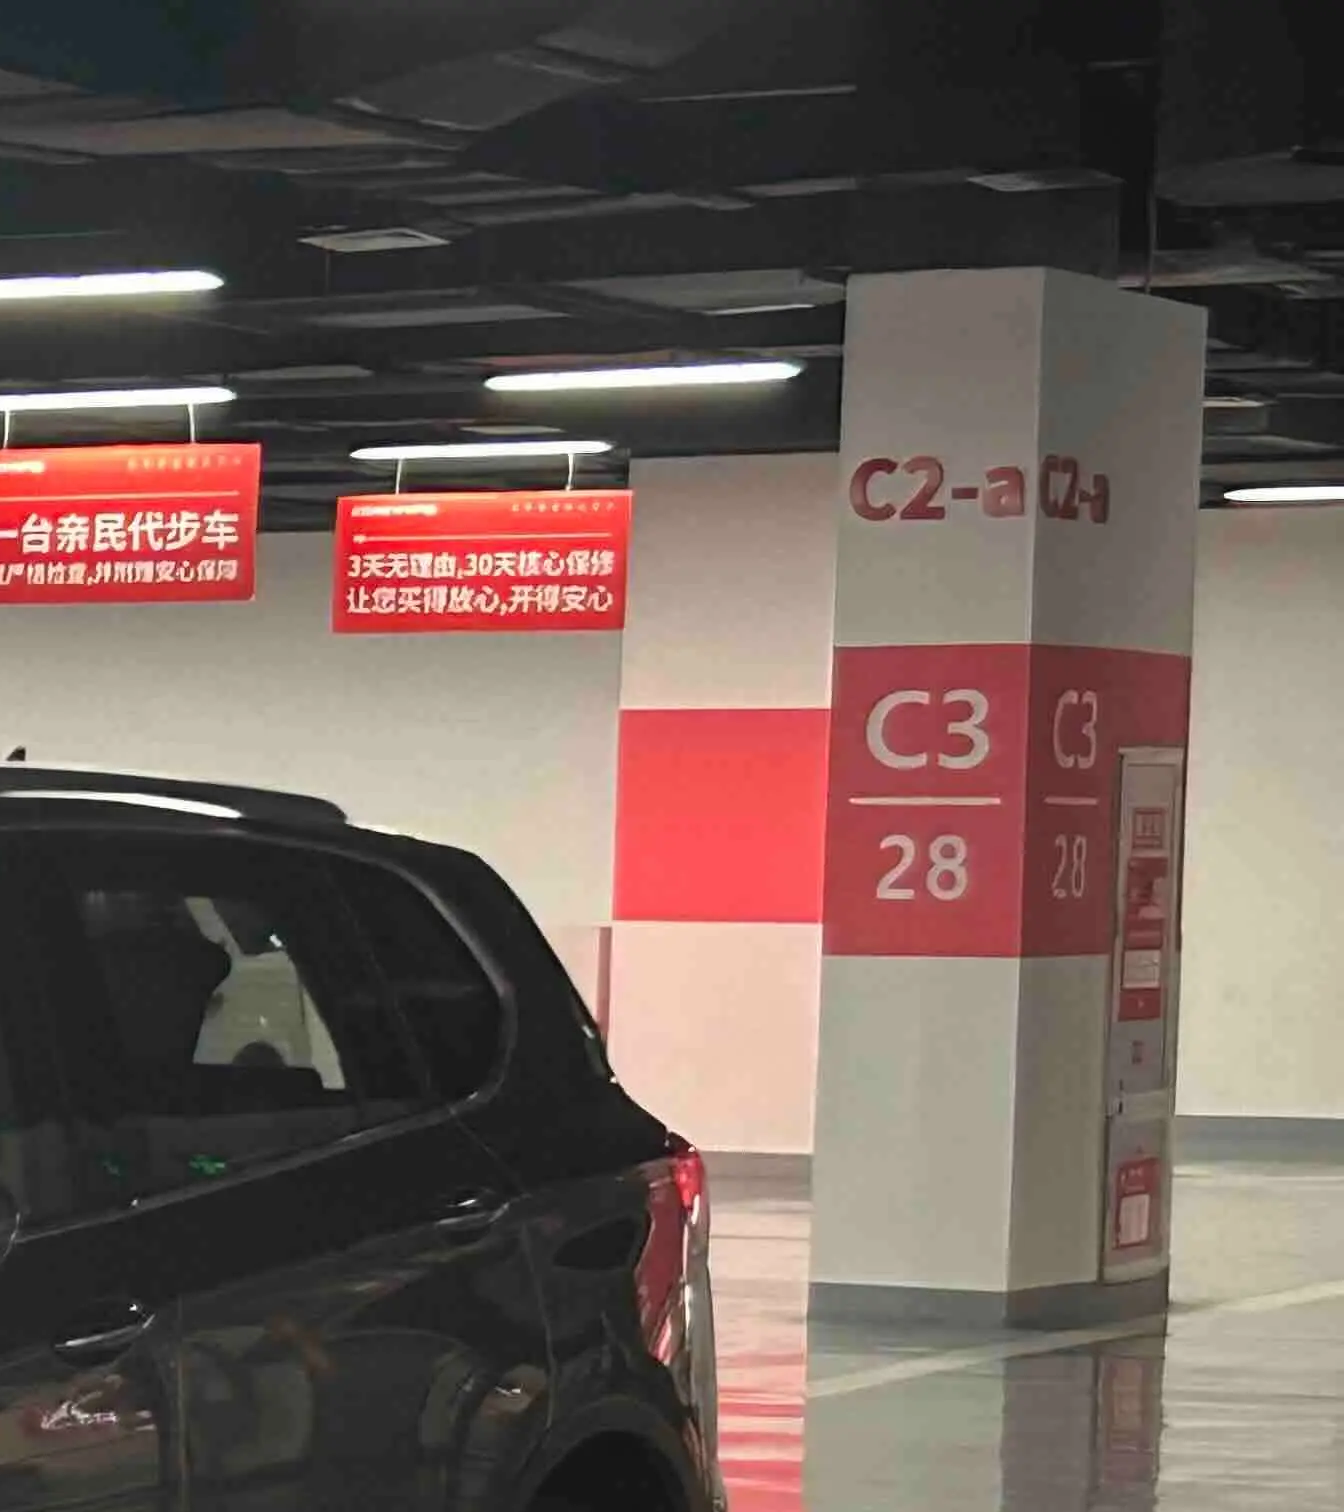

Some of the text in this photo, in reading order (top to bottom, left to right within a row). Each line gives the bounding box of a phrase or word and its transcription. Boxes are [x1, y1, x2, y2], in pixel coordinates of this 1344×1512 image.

[848, 455, 1026, 523] C2-a
[346, 585, 614, 617] 让您买得放心,开得安心
[865, 689, 991, 770] C3
[1052, 690, 1098, 769] C3
[875, 834, 969, 901] 28
[1051, 834, 1087, 899] 28
